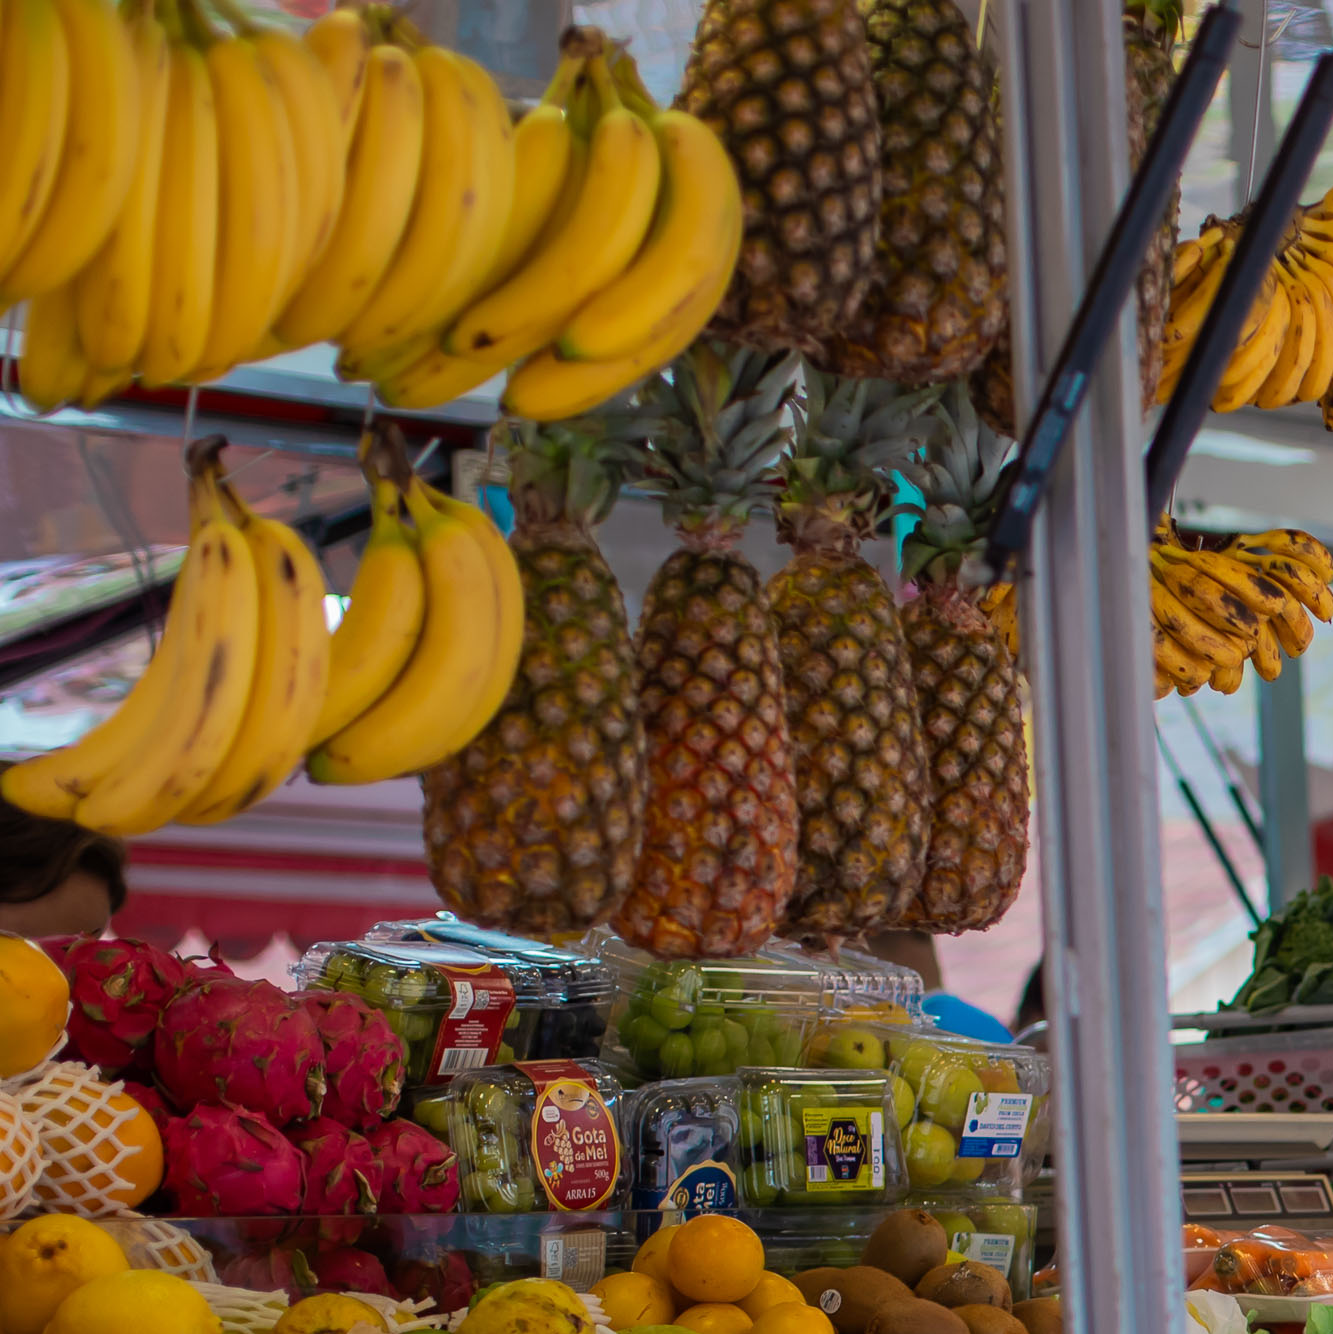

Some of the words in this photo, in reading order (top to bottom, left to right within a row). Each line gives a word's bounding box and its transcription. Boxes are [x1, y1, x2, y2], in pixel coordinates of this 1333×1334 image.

[572, 1126, 606, 1145] Gota
[575, 1150, 585, 1160] de
[586, 1143, 607, 1160] Mel
[827, 1139, 861, 1155] Natural
[594, 1169, 610, 1181] 500g
[565, 1188, 587, 1200] ARRA
[588, 1187, 596, 1199] 15
